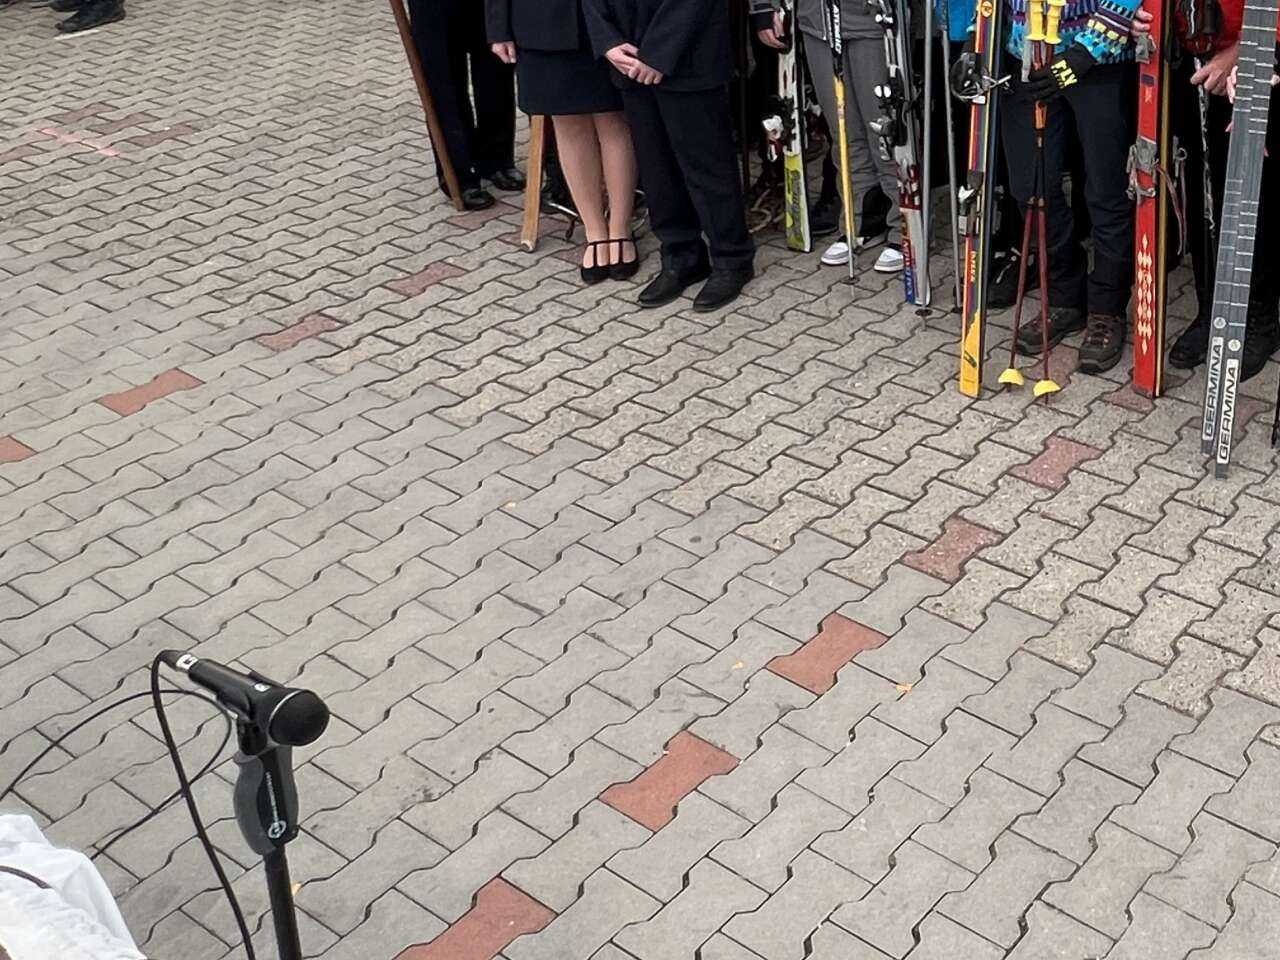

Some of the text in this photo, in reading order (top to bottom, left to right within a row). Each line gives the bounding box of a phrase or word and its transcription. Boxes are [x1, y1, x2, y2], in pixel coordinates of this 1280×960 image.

[1055, 60, 1078, 86] FLY
[1205, 344, 1222, 436] GERMINA
[1219, 367, 1236, 459] GERMINA
